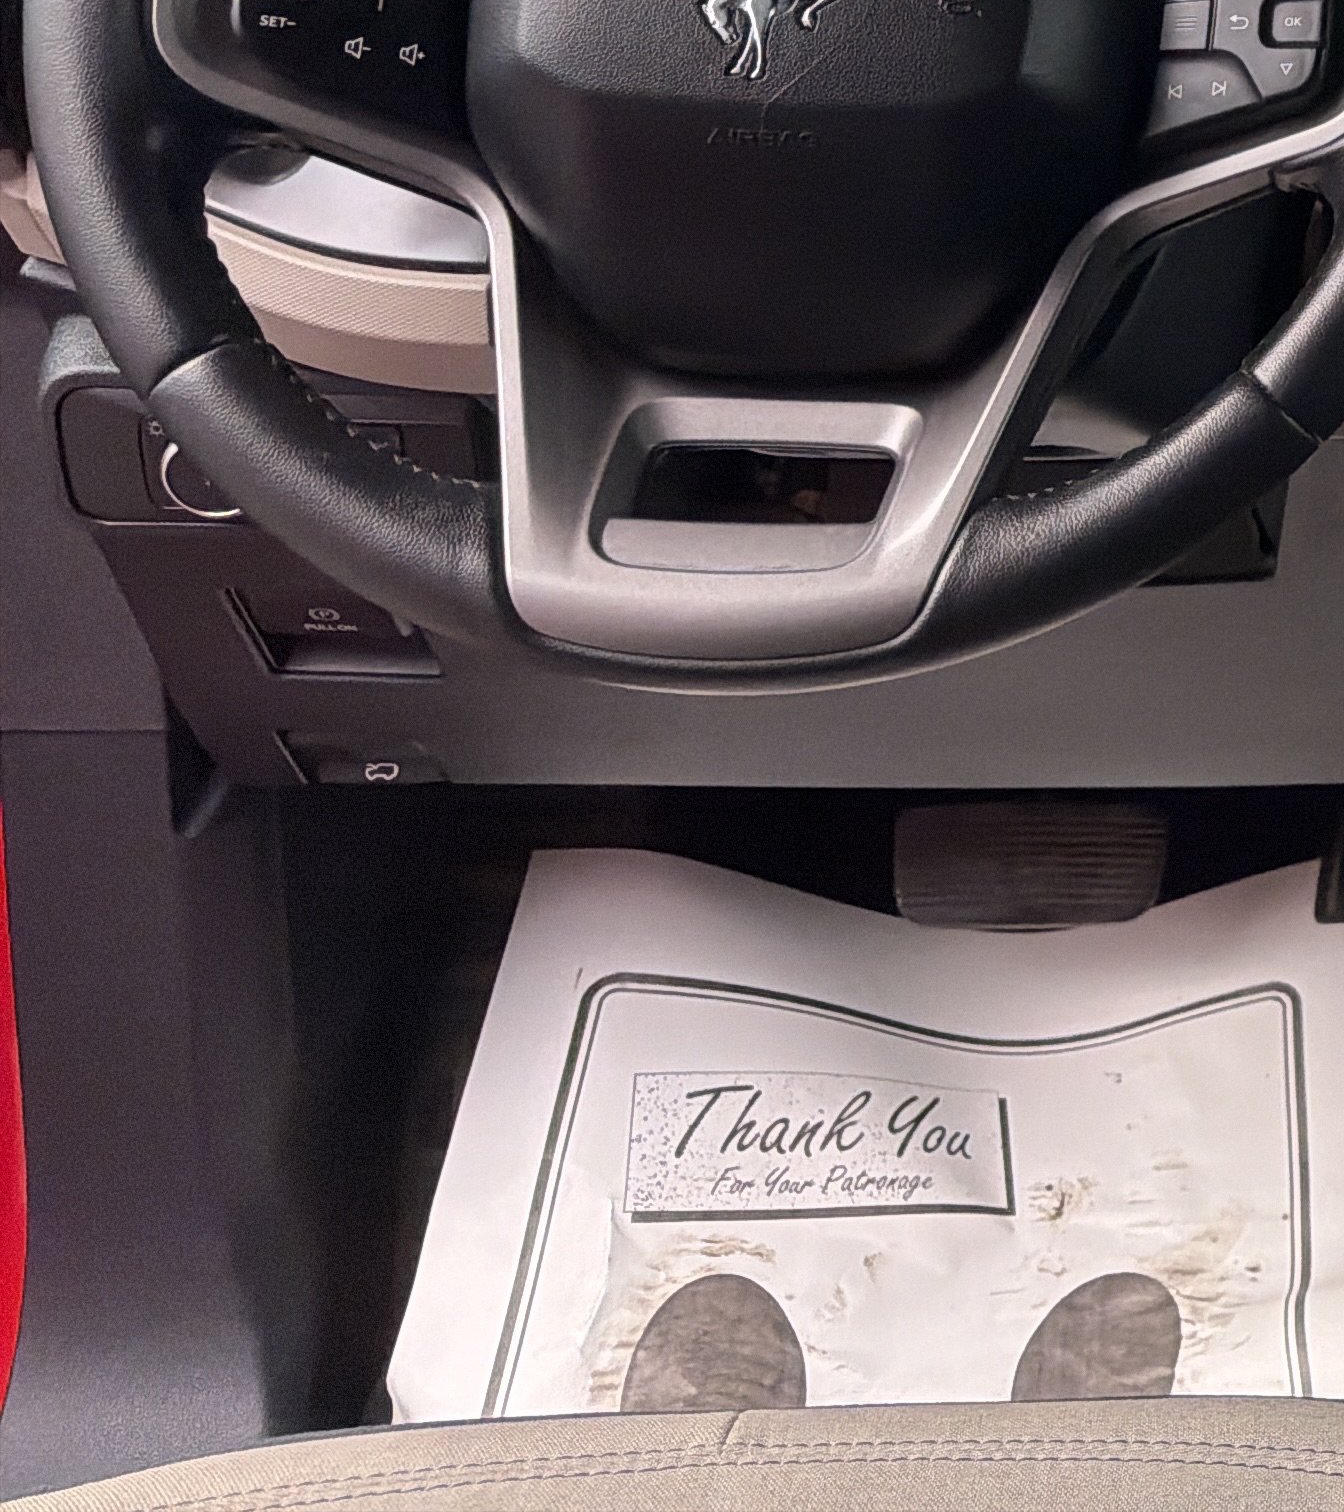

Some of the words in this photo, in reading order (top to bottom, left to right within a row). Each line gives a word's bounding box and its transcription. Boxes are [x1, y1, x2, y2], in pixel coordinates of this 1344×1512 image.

[1284, 16, 1302, 27] OK
[674, 1084, 873, 1159] Thank
[887, 1094, 973, 1160] You
[710, 1164, 755, 1197] For
[764, 1165, 815, 1196] Your
[820, 1163, 935, 1202] Patronage
